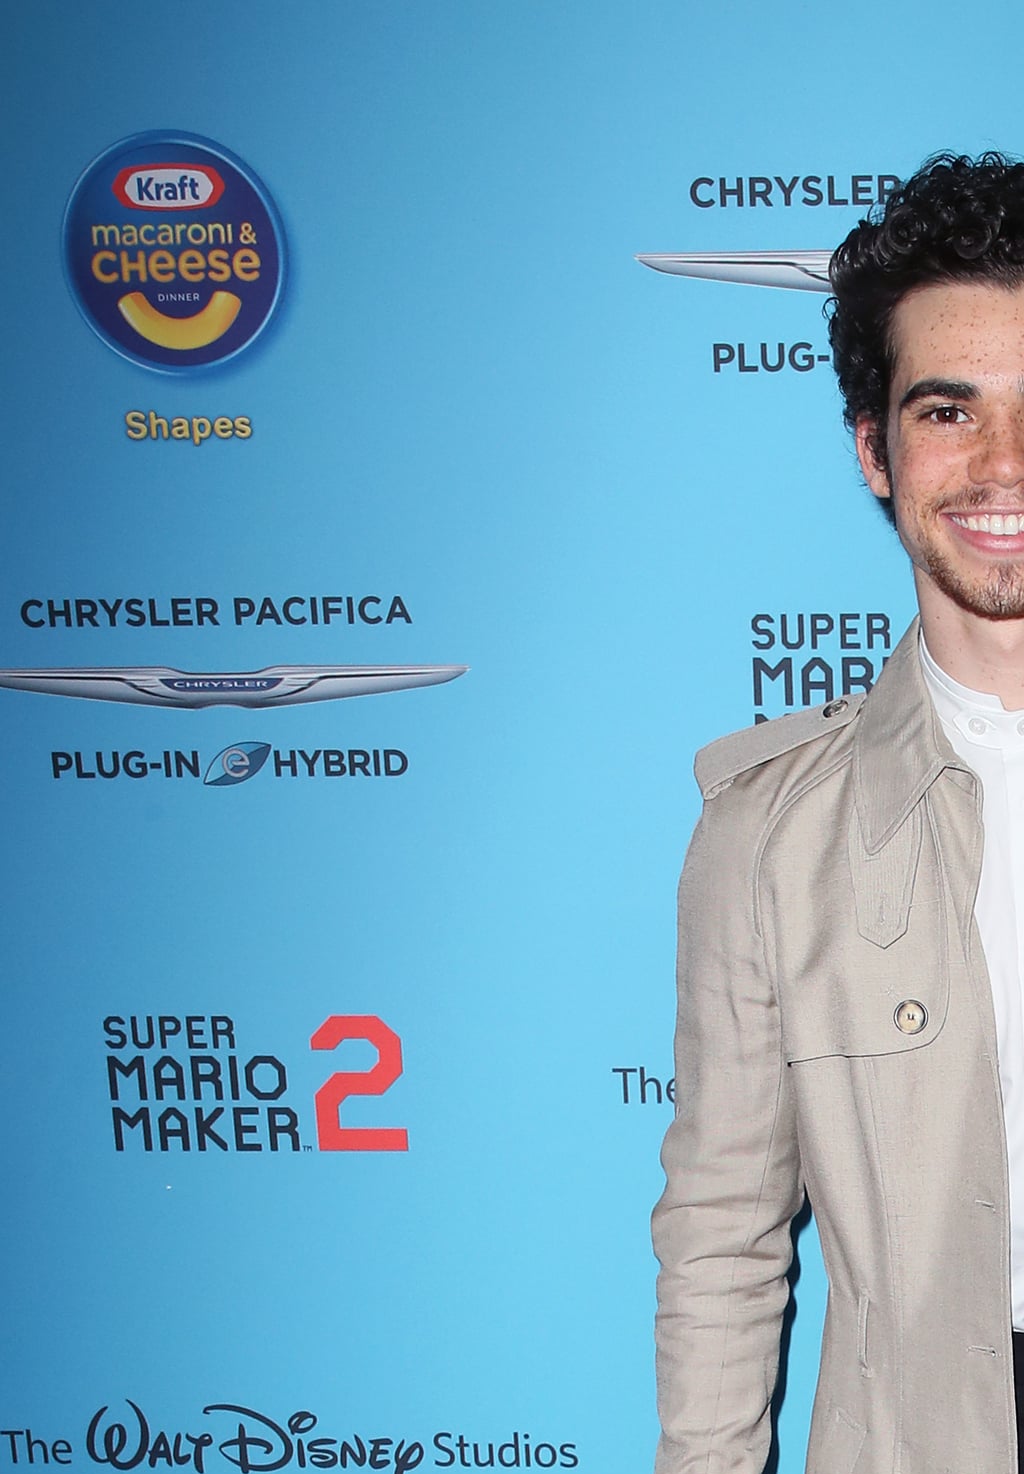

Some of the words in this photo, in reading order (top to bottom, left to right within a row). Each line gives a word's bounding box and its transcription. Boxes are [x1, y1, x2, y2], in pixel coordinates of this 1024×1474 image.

[136, 176, 200, 201] Kraft
[91, 222, 233, 247] macaroni
[239, 222, 258, 245] &
[157, 292, 201, 302] DINNER
[712, 342, 833, 373] PLUG-
[125, 410, 254, 446] Shapes
[20, 598, 220, 628] CHRYSLER
[233, 596, 413, 626] PACIFICA
[751, 613, 891, 650] SUPER
[173, 679, 269, 689] CHRYSLER
[752, 657, 889, 706] MAR
[51, 750, 200, 779] PLUG-IN
[273, 749, 409, 777] HYBRID
[103, 1016, 236, 1050] SUPER
[106, 1055, 288, 1101] MARIO
[310, 1015, 409, 1152] 2
[111, 1106, 301, 1152] MAKER
[0, 1429, 73, 1465] The
[433, 1431, 580, 1469] Studios
